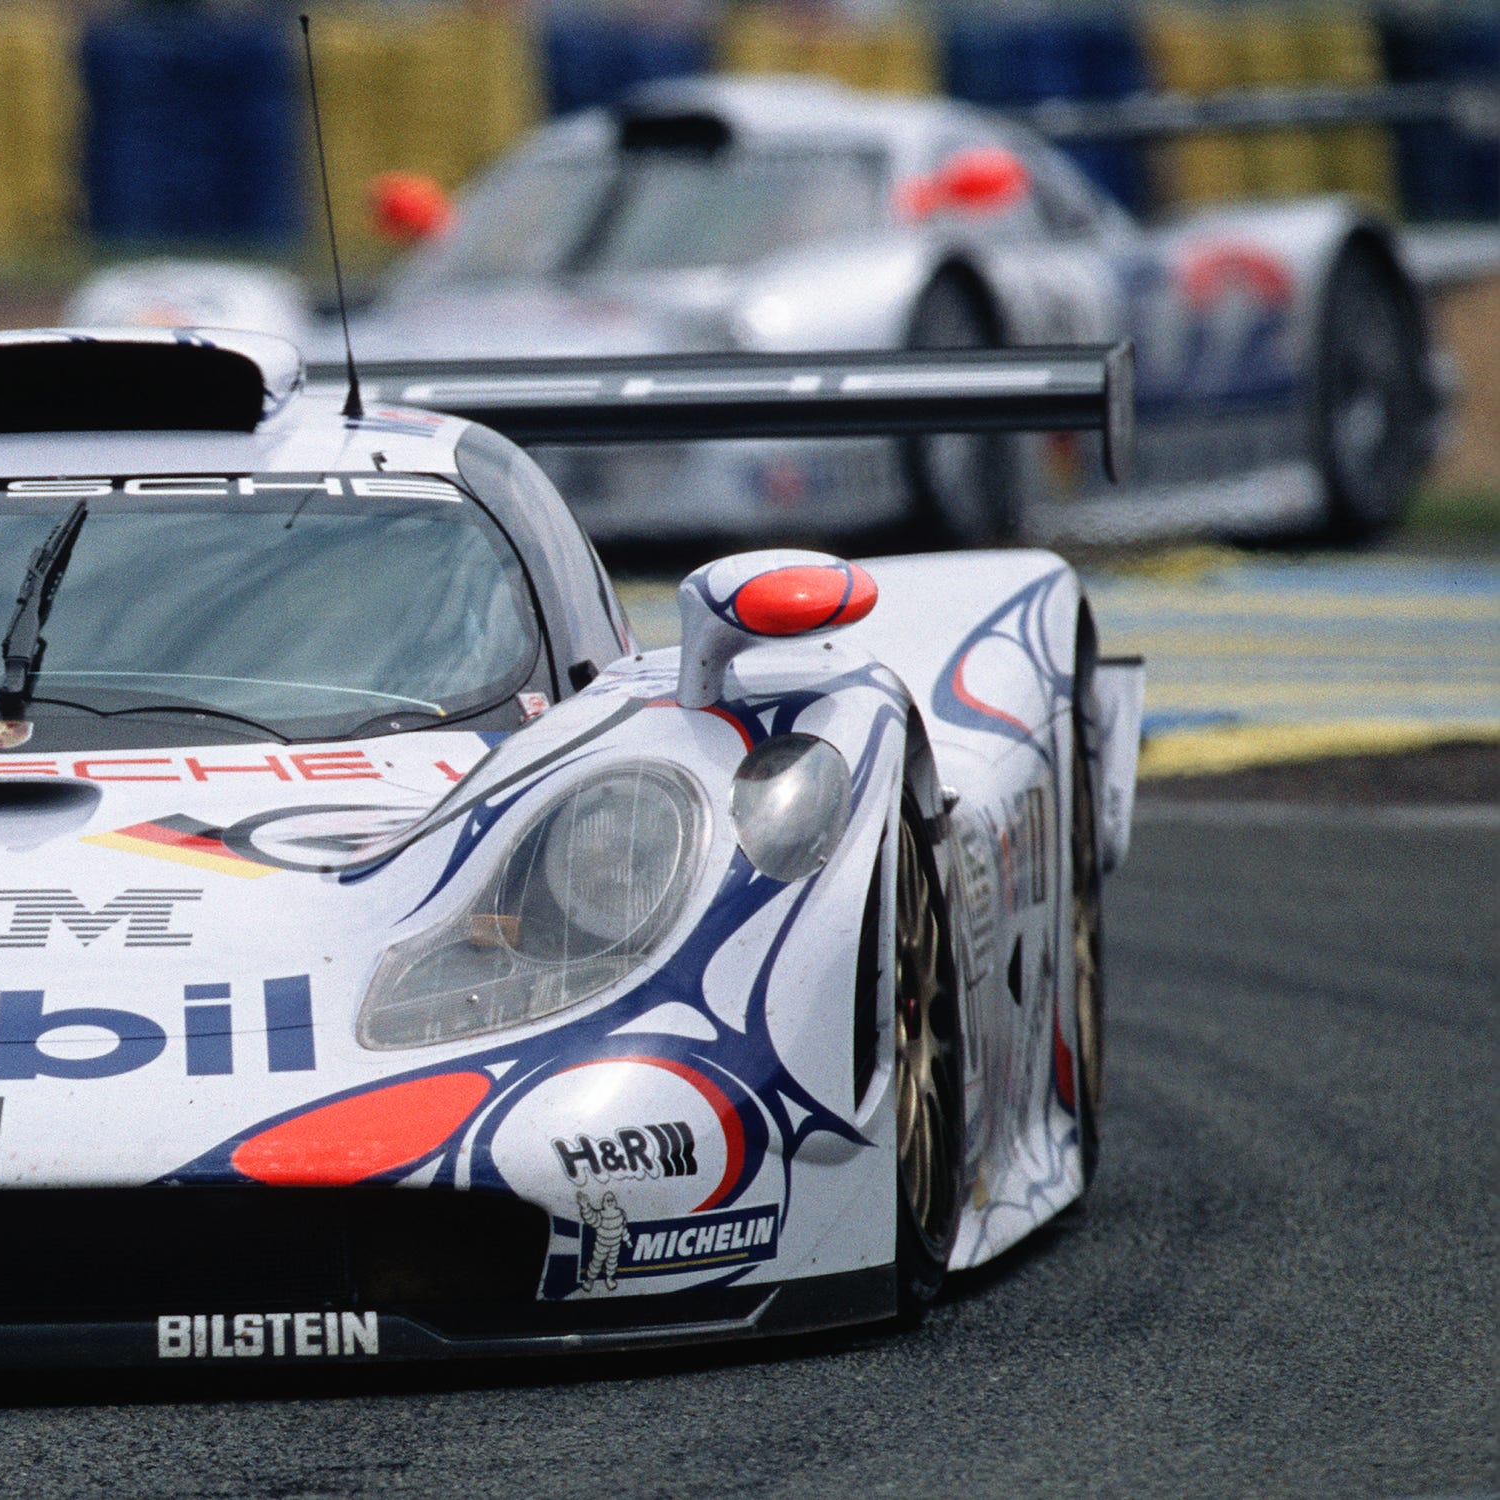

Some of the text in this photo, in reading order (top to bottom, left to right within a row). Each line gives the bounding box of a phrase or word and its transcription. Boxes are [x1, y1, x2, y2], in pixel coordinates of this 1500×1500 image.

[554, 1126, 656, 1184] H&R
[632, 1216, 775, 1262] MICHELIN
[158, 1311, 378, 1358] BILSTEIN
